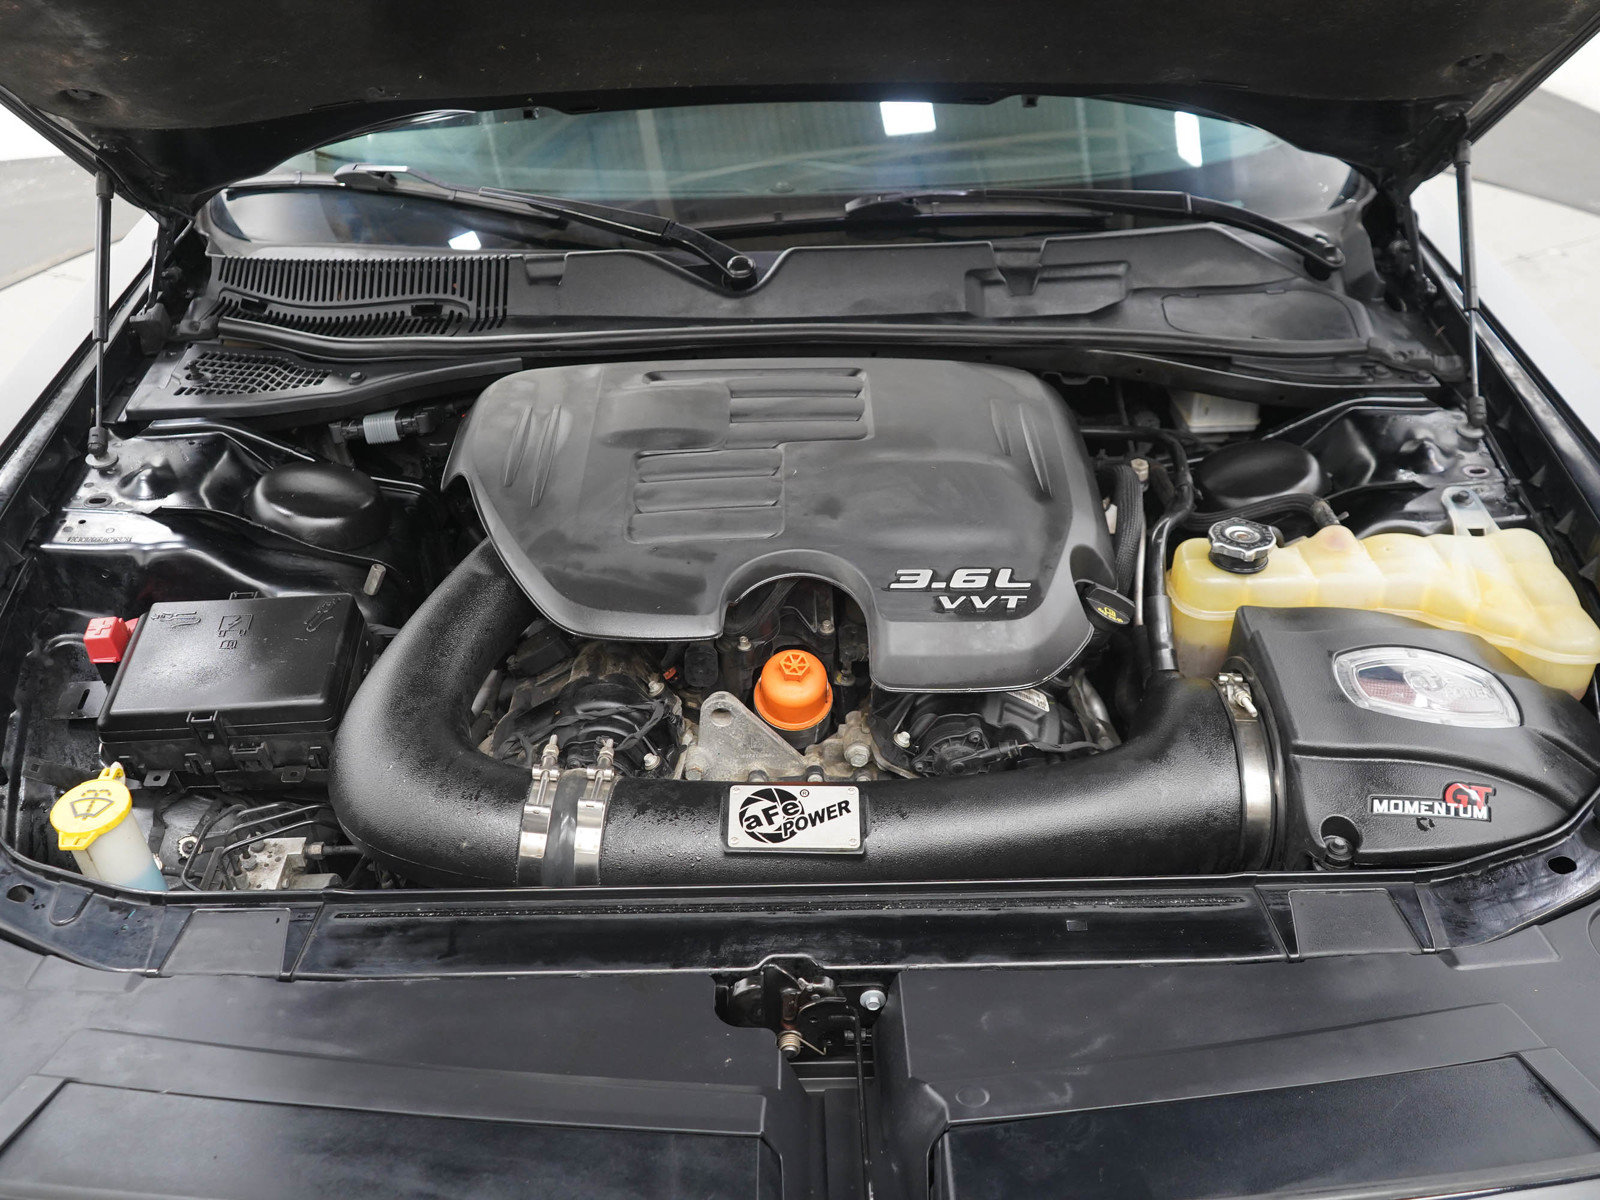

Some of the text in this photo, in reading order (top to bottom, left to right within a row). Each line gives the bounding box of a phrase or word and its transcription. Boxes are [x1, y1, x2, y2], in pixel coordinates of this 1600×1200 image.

[889, 568, 1032, 589] 3.6L
[938, 595, 1028, 611] VVT
[1445, 782, 1493, 809] GT
[743, 800, 800, 830] aFe
[782, 799, 851, 837] POWER
[1372, 798, 1488, 820] MOMENTUM
